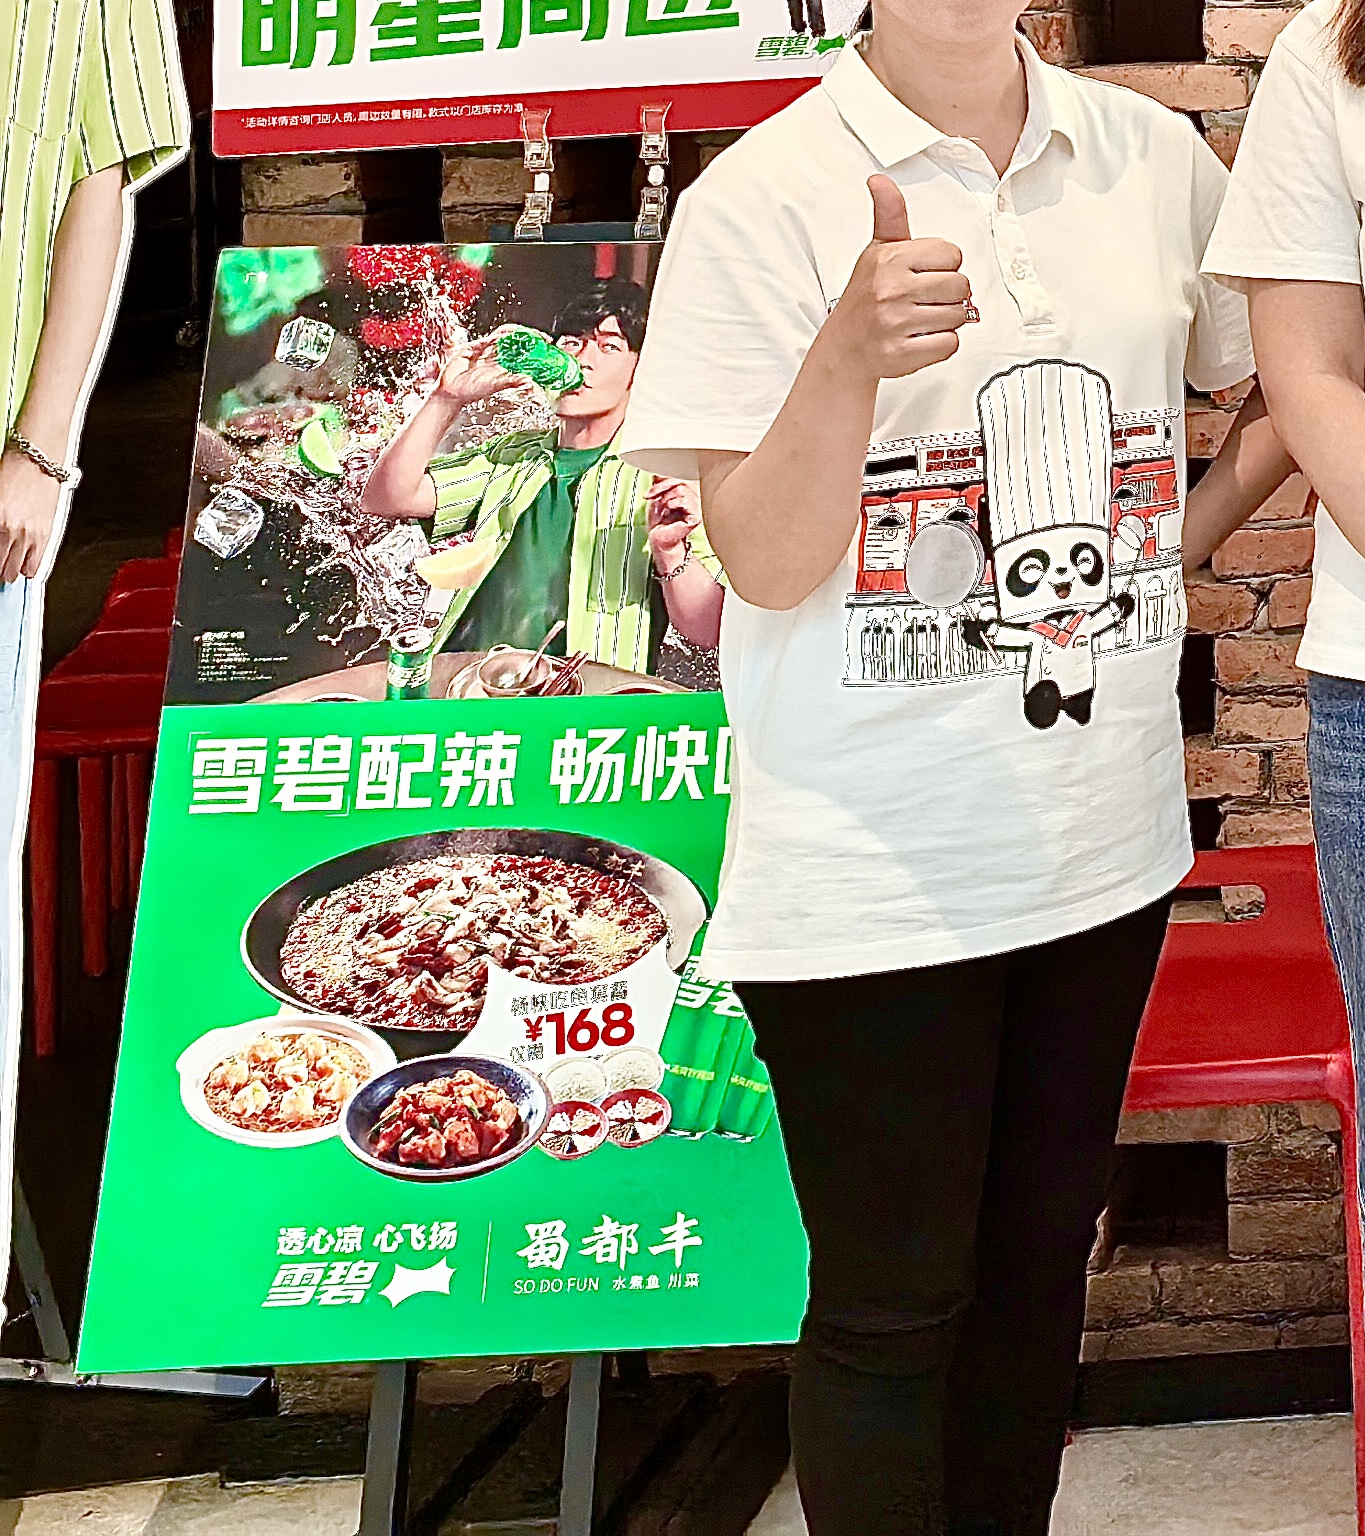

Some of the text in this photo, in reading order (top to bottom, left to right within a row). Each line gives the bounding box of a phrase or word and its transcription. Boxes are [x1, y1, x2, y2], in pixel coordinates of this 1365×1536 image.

[276, 1221, 458, 1256] 透心凉 心飞扬
[516, 1211, 703, 1271] 蜀都丰
[260, 1259, 380, 1308] 雪碧
[567, 1276, 600, 1293] FUN
